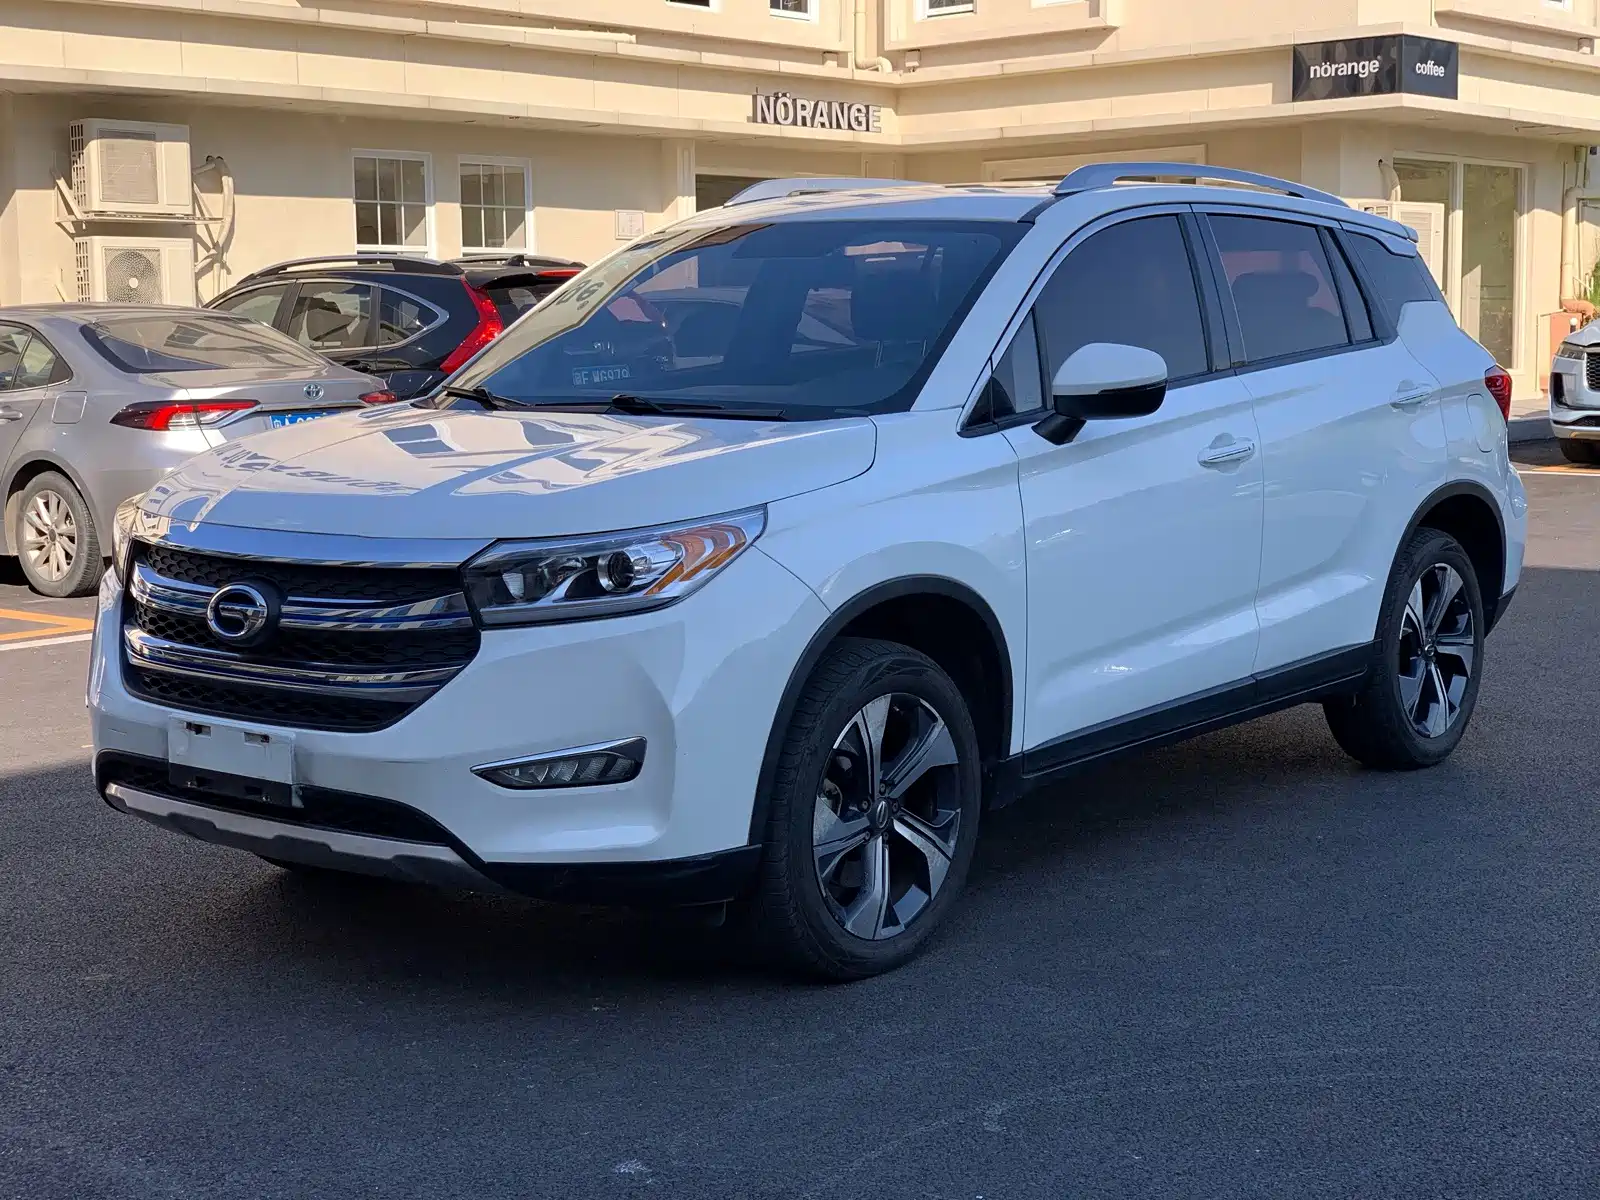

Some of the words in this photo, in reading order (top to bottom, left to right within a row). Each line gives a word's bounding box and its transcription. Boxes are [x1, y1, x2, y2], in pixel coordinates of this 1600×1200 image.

[1310, 59, 1380, 79] nörange
[1415, 60, 1445, 77] coffee
[754, 92, 882, 133] NÖRANGE
